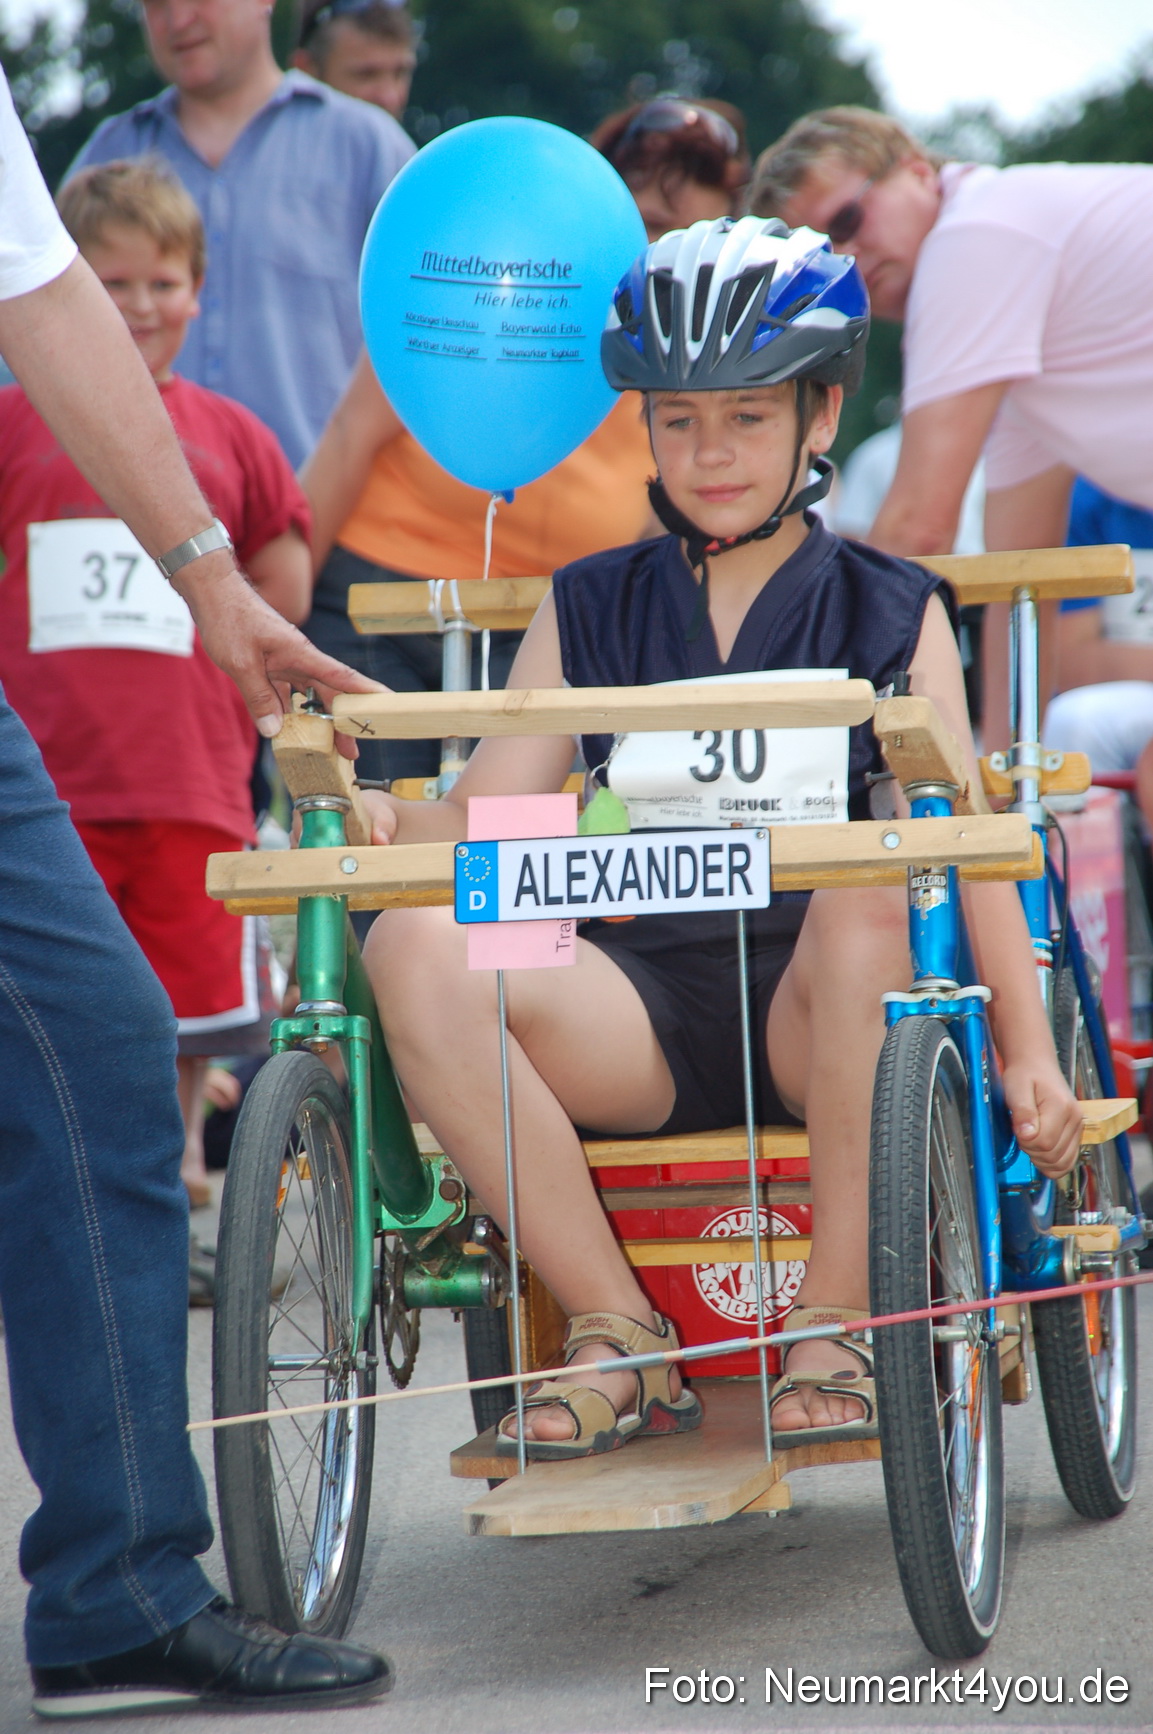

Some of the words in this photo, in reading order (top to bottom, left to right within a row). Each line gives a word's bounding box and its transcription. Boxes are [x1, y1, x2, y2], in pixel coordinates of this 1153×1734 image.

[421, 250, 572, 279] Mittelbayerische
[474, 291, 507, 306] Hier
[511, 292, 543, 308] lebe
[547, 294, 571, 308] ich.
[501, 321, 556, 334] Bayerwald
[560, 323, 582, 333] Echo
[442, 343, 480, 355] Anzeiger
[83, 551, 140, 601] 37
[689, 728, 767, 783] 30
[719, 797, 782, 811] DRUCK
[513, 843, 753, 908] ALEXANDER
[911, 875, 947, 888] RECORD
[469, 891, 487, 910] D
